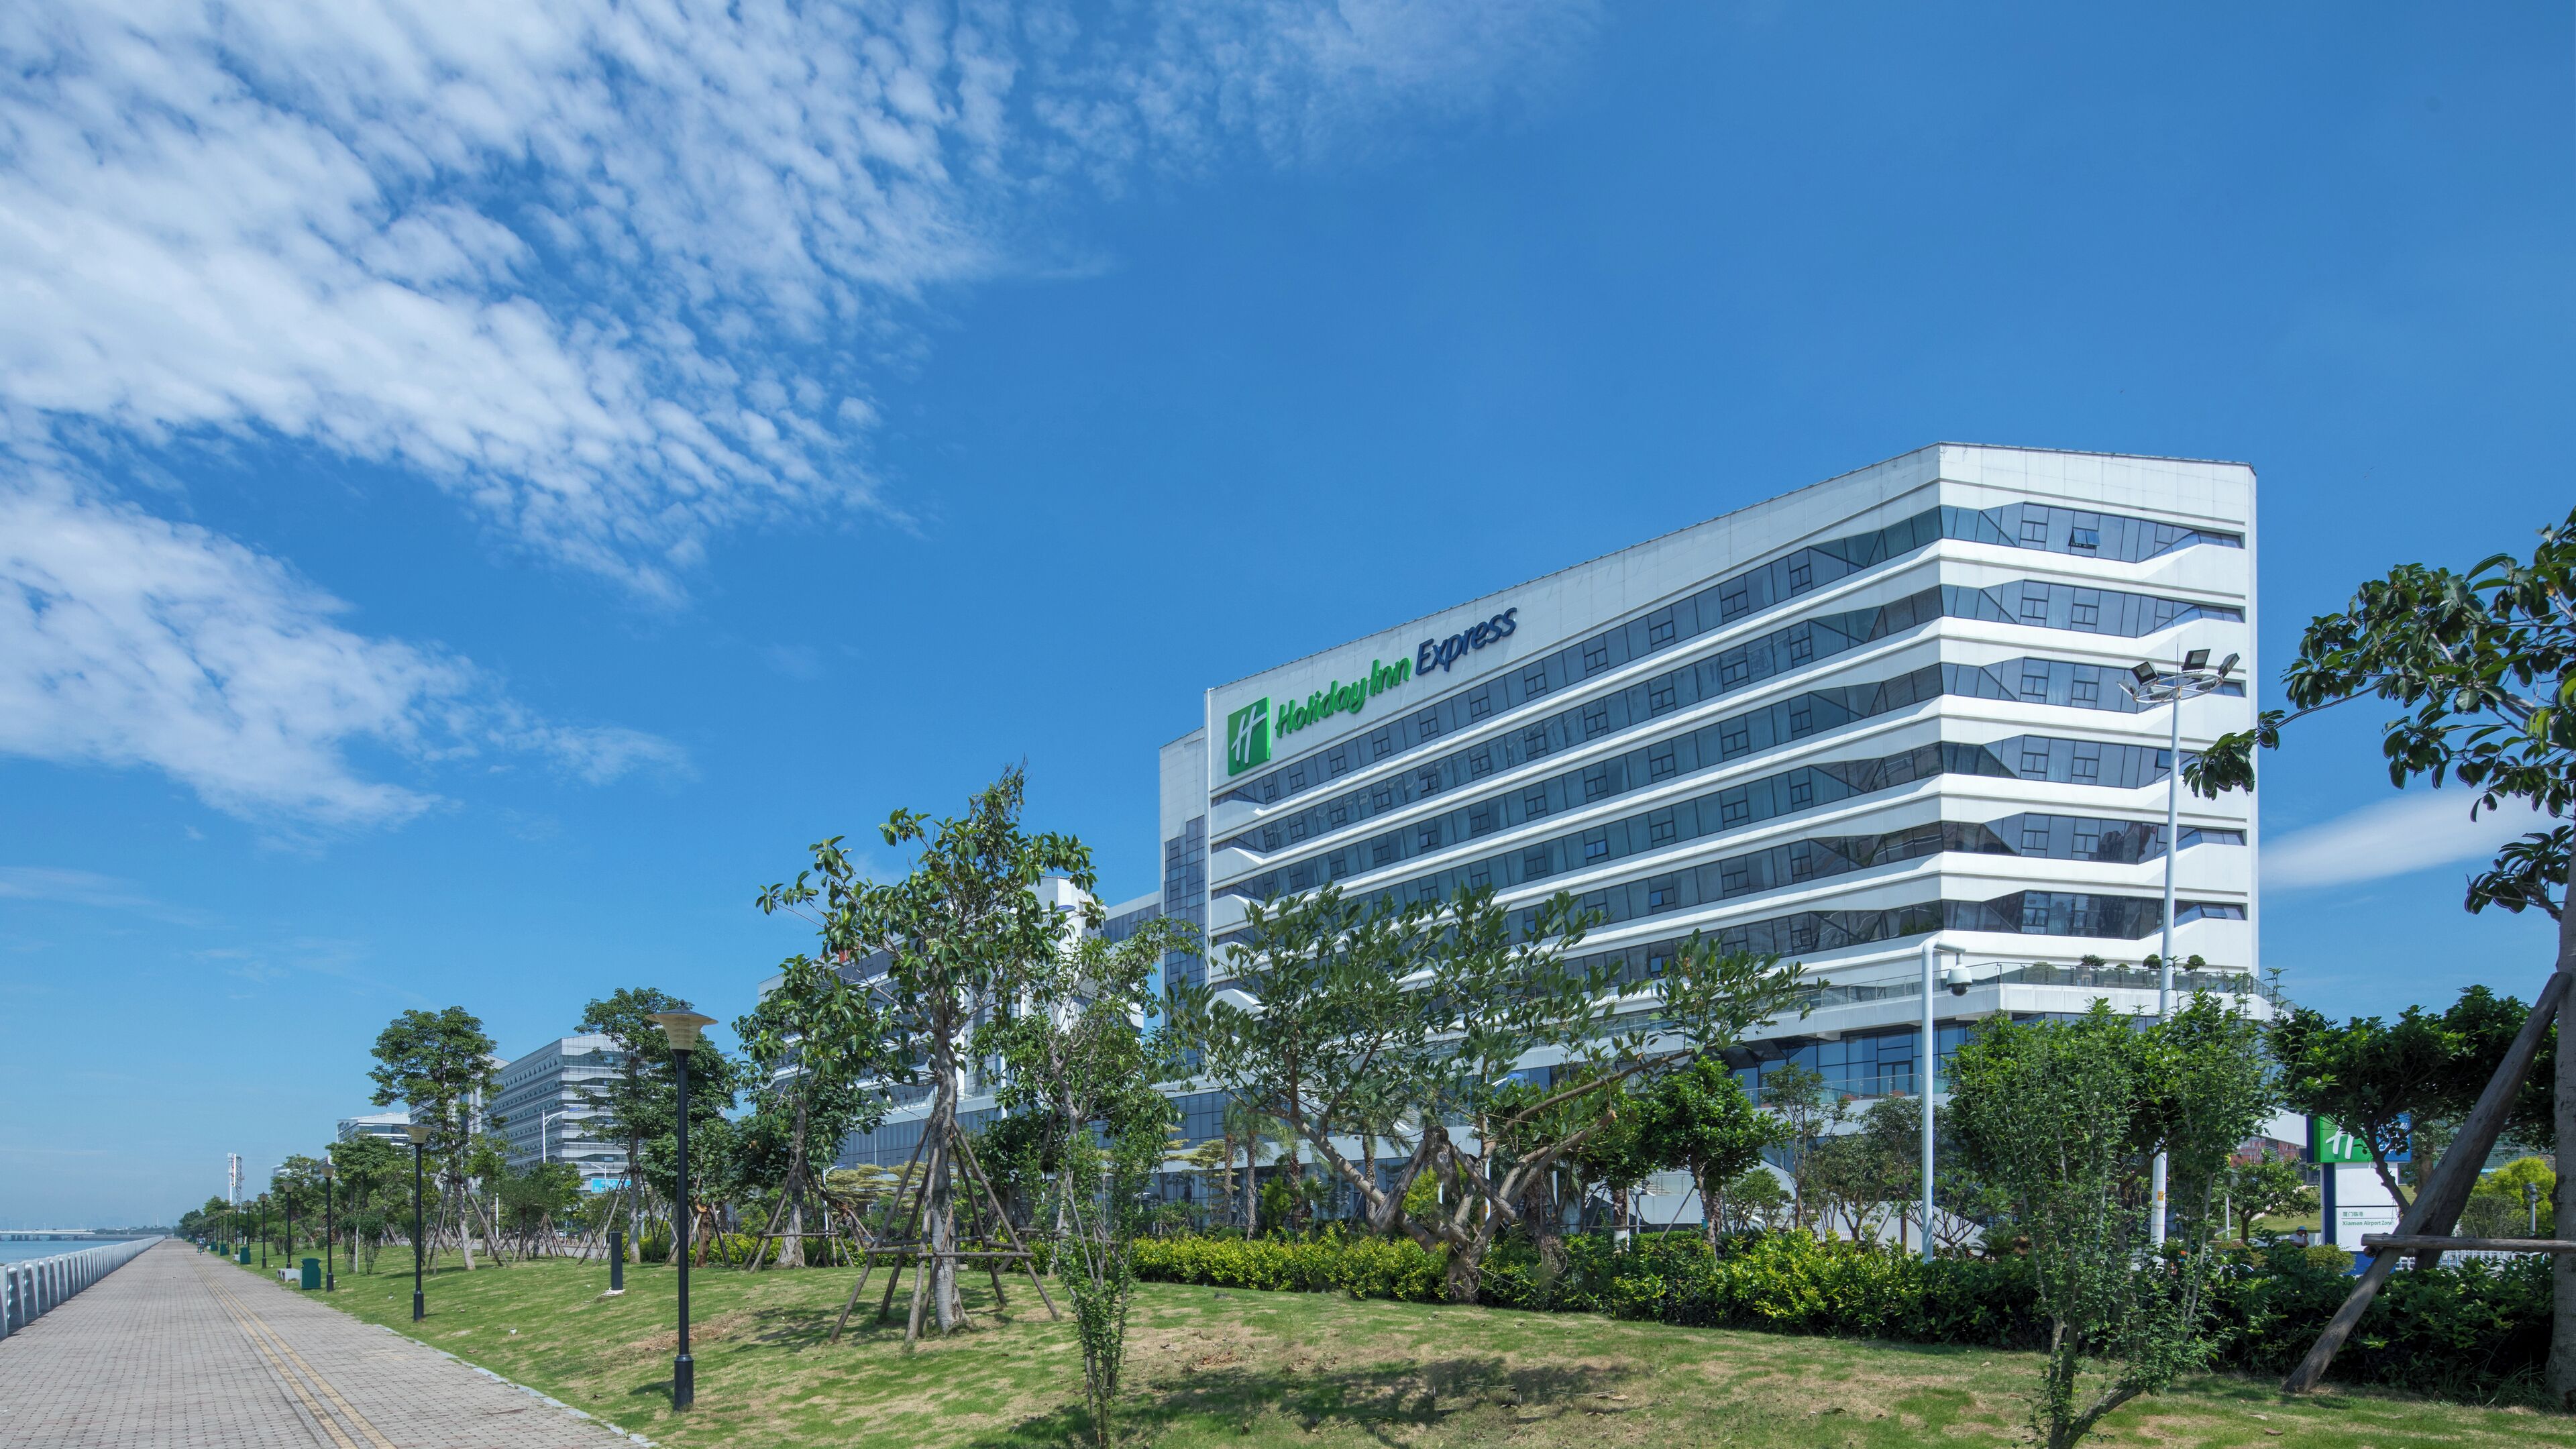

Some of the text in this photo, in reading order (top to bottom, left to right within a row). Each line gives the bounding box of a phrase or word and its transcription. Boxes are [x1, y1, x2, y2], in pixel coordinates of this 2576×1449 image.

[1275, 678, 1367, 738] Holiday
[1369, 657, 1411, 696] Inn
[1415, 607, 1517, 676] Express
